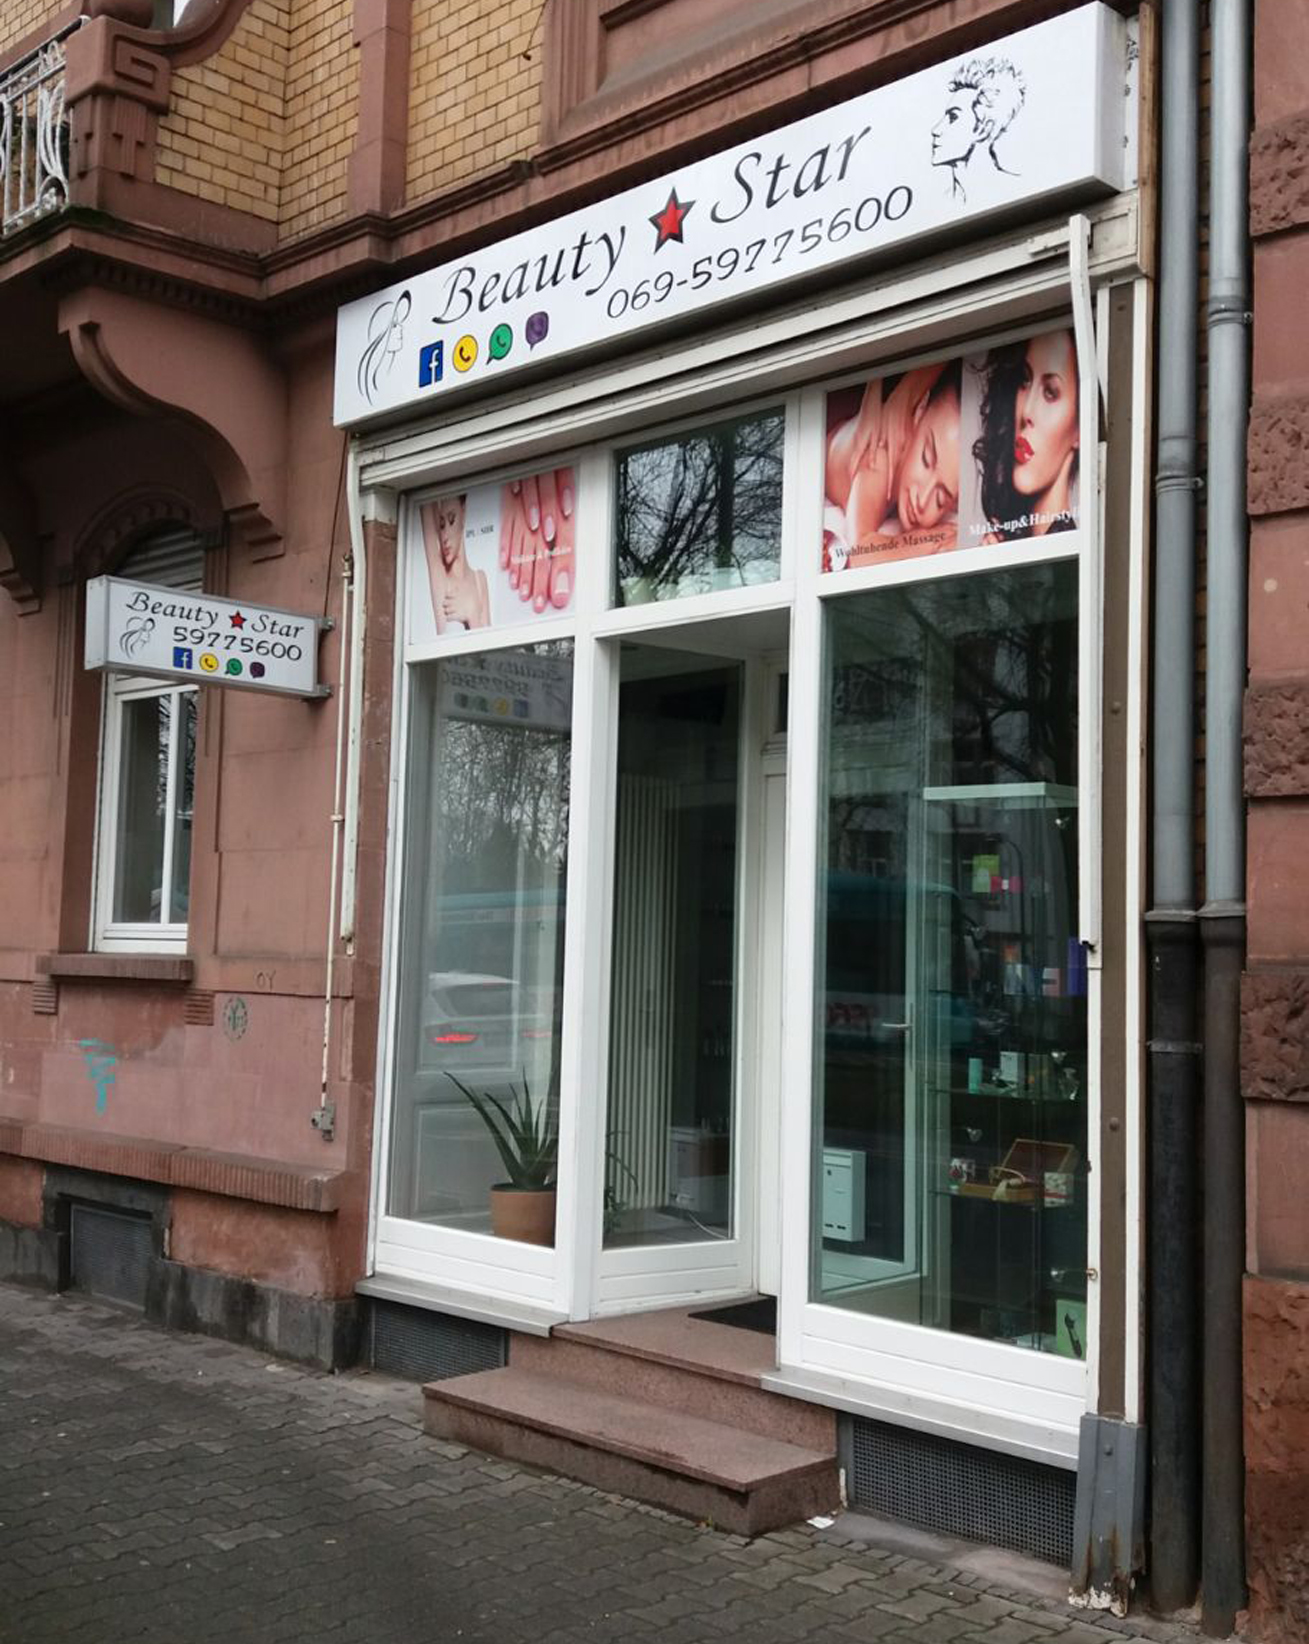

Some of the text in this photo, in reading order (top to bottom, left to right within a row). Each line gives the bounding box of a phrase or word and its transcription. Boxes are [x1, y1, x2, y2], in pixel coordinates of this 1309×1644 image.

[432, 126, 871, 324] Beauty Star
[607, 186, 913, 319] 069-59775600
[902, 532, 946, 547] Massage
[126, 591, 304, 639] Beauty Star
[173, 626, 302, 661] 59775600
